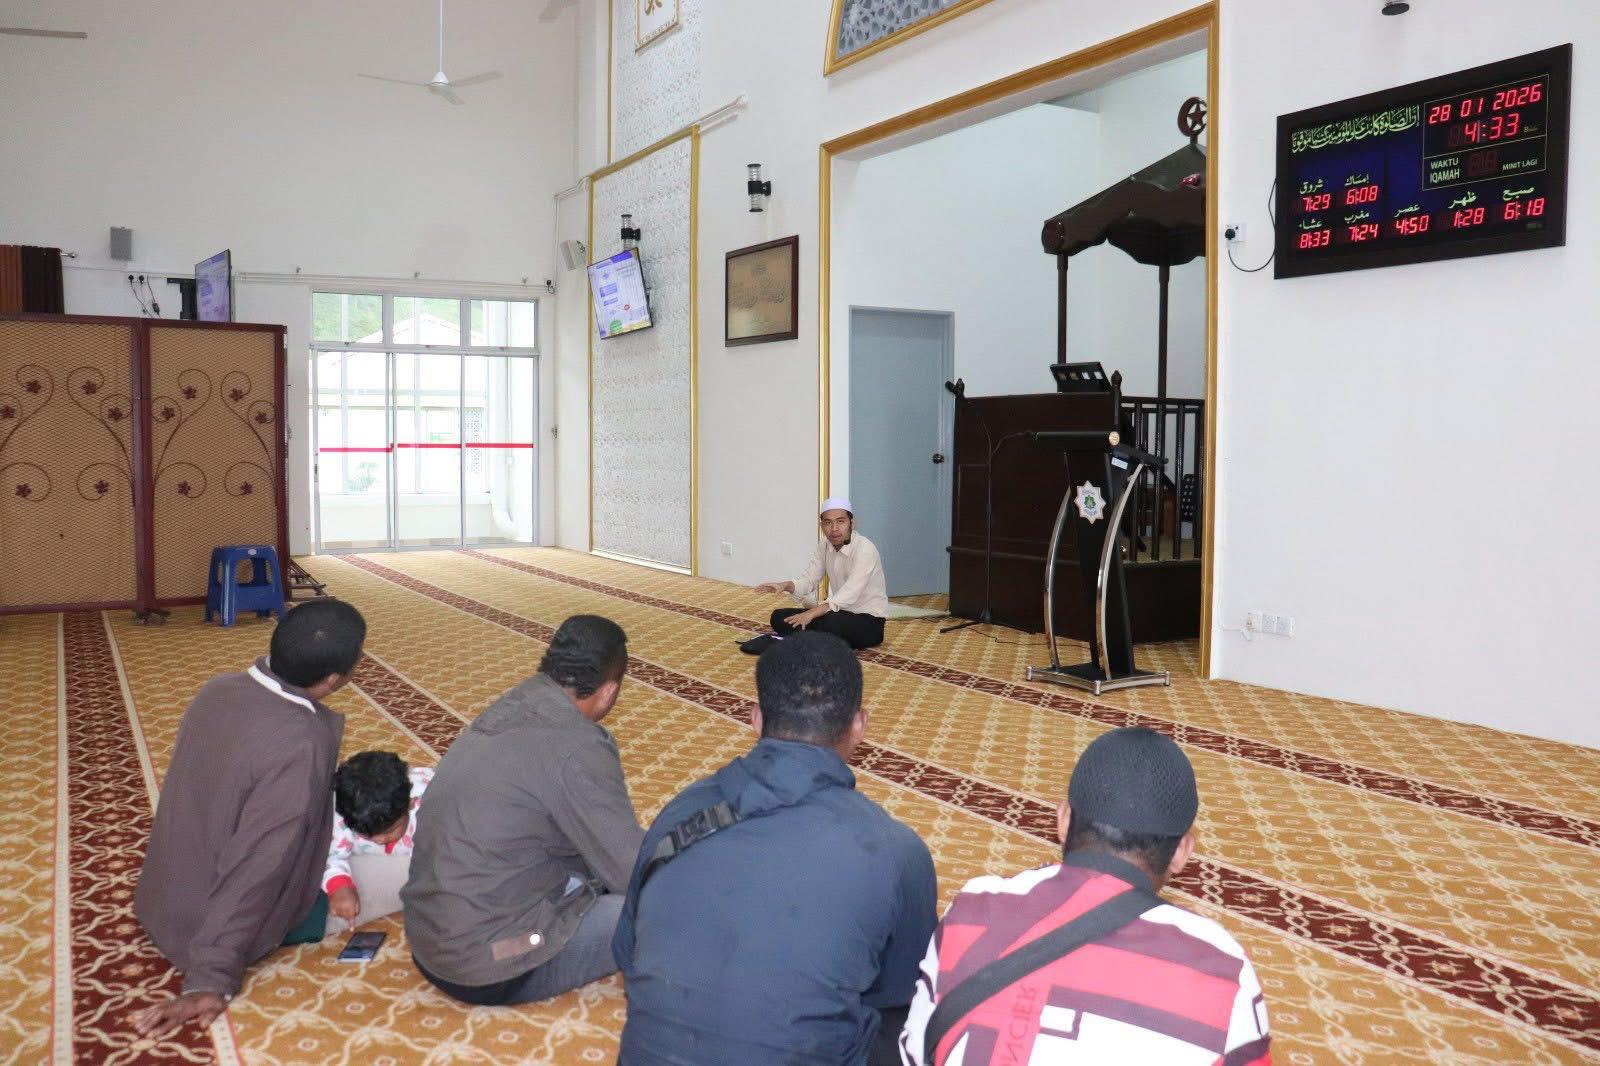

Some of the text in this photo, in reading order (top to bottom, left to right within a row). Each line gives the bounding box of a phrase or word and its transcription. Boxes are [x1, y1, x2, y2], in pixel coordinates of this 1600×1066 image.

[1429, 84, 1542, 124] 28 01 2026
[1464, 113, 1519, 142] 4:33
[1430, 158, 1459, 170] WAKTU
[1502, 160, 1538, 170] MINIT LAGI
[1430, 169, 1460, 184] IQAMAH
[1300, 179, 1323, 194] شروق
[1503, 187, 1535, 201] صبح
[1346, 186, 1378, 204] 6:08
[1448, 191, 1477, 209] ظهر
[1394, 205, 1420, 217] عصر
[1504, 198, 1545, 220] 6:18
[1345, 211, 1370, 224] مغرب
